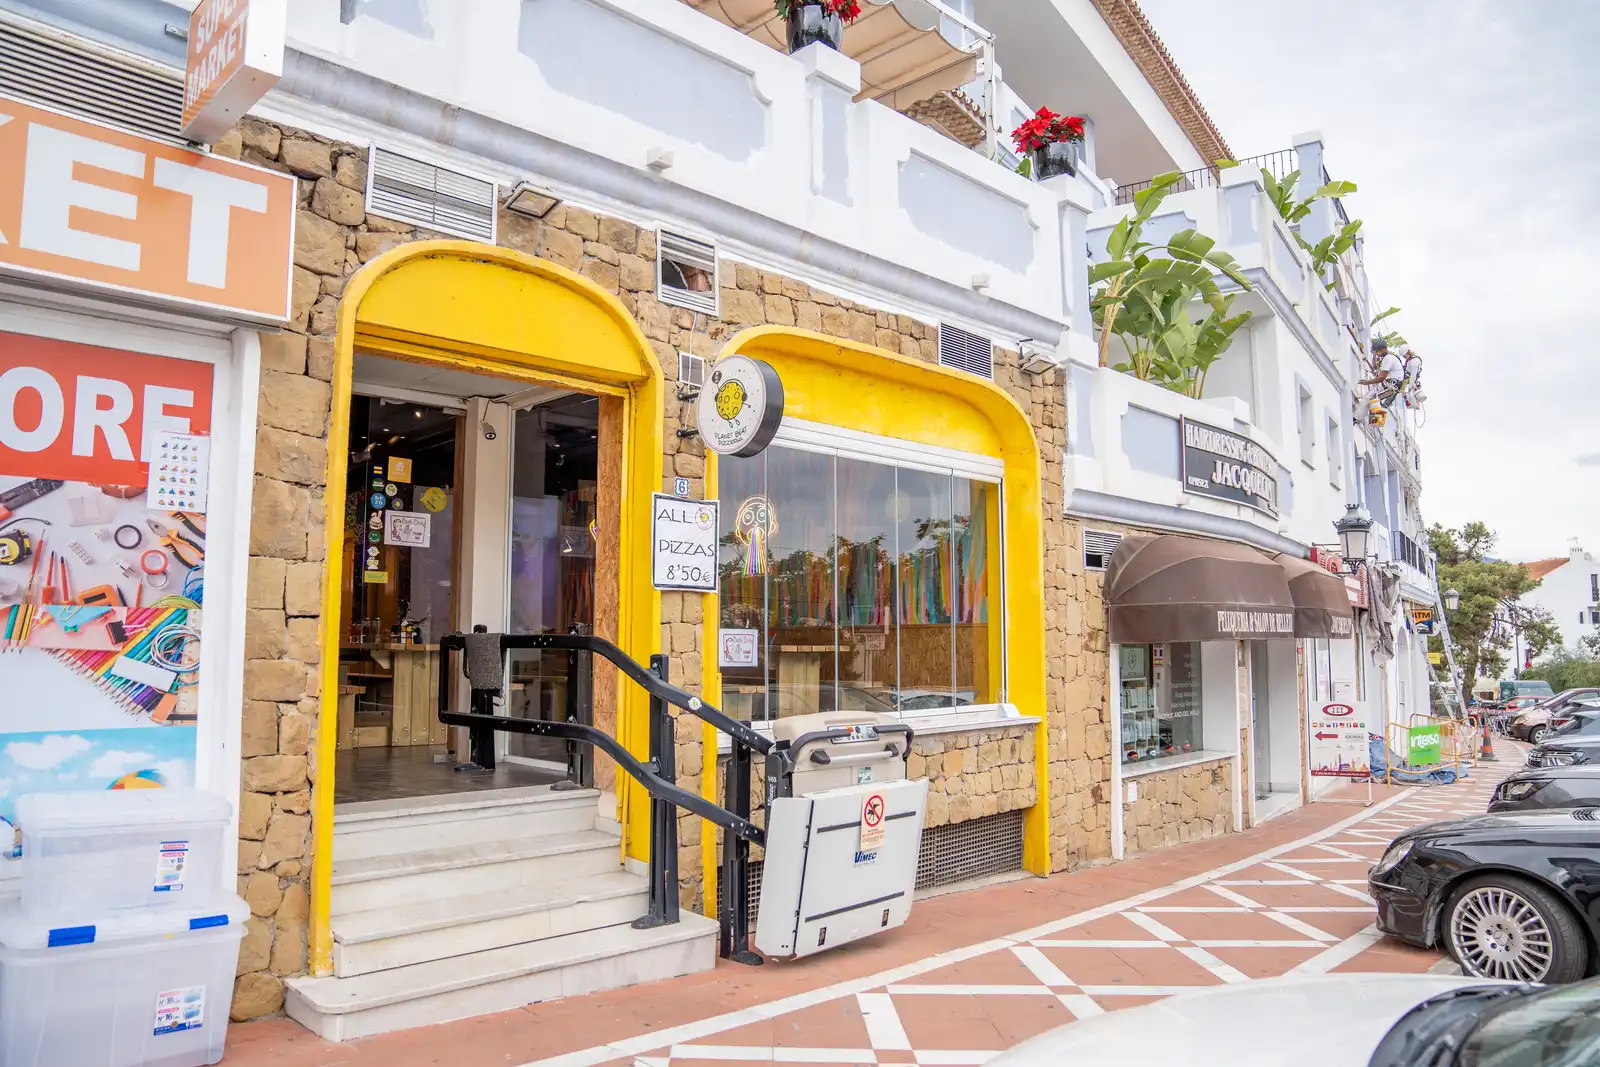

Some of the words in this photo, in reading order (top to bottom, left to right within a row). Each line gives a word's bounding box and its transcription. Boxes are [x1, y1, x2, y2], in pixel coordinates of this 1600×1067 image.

[186, 7, 248, 111] MARKET
[0, 114, 269, 290] ET
[714, 432, 733, 440] PLANET
[735, 424, 748, 438] BEAT
[679, 481, 686, 494] 6
[657, 508, 693, 524] ALL
